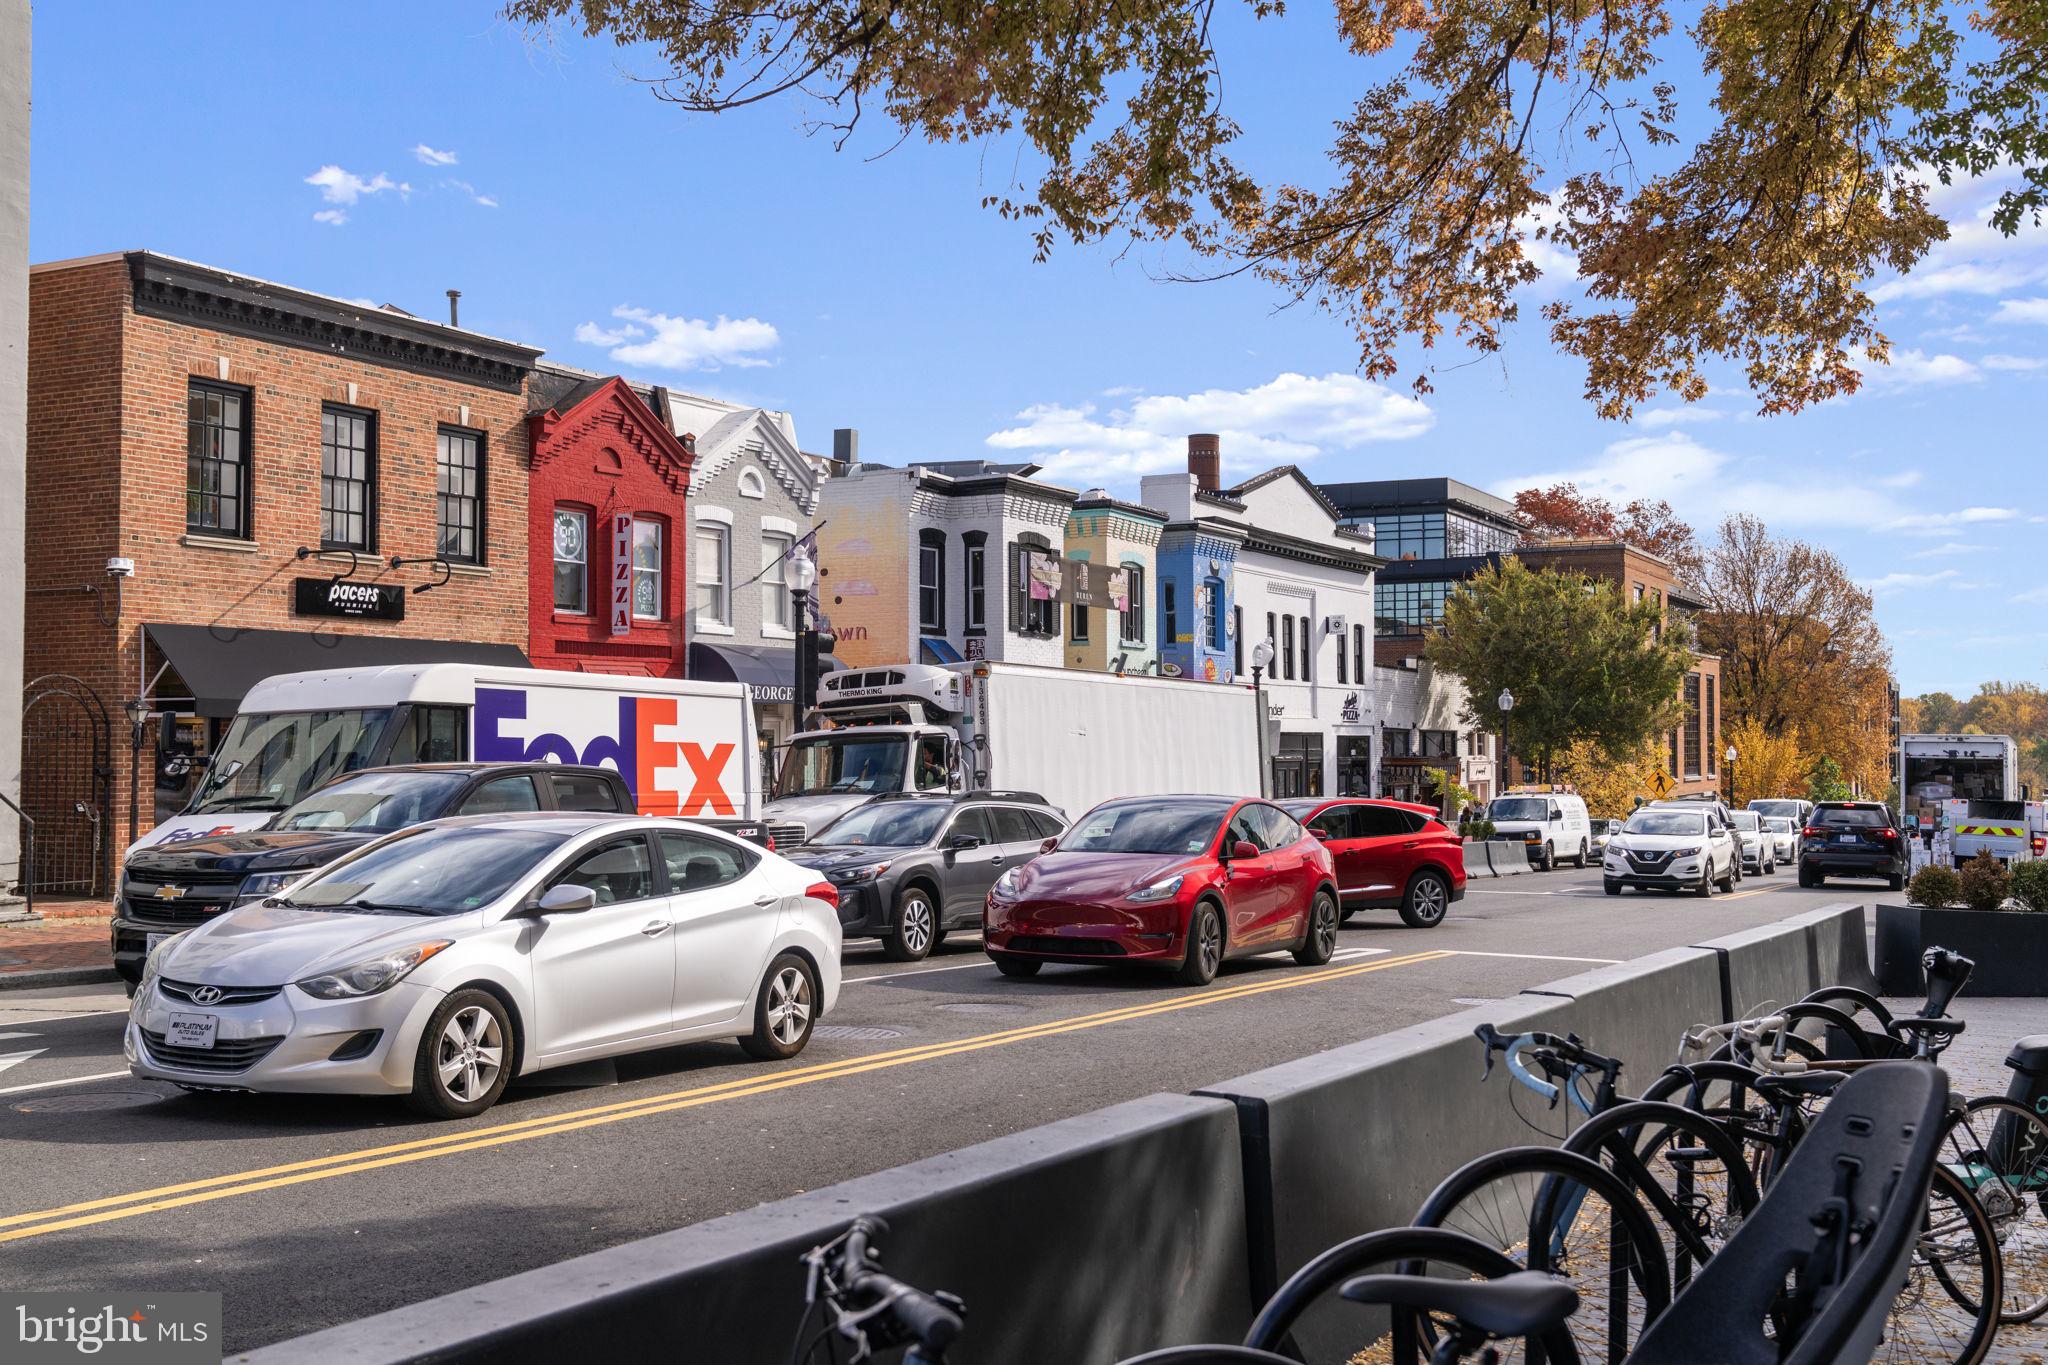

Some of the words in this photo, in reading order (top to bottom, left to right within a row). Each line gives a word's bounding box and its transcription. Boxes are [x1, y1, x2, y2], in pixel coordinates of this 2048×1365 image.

[613, 517, 631, 627] PIZZA
[328, 584, 379, 602] pacers
[748, 685, 796, 701] GEORGE
[838, 689, 866, 698] THERMO
[866, 687, 883, 695] KING
[1342, 709, 1359, 721] PIZZA
